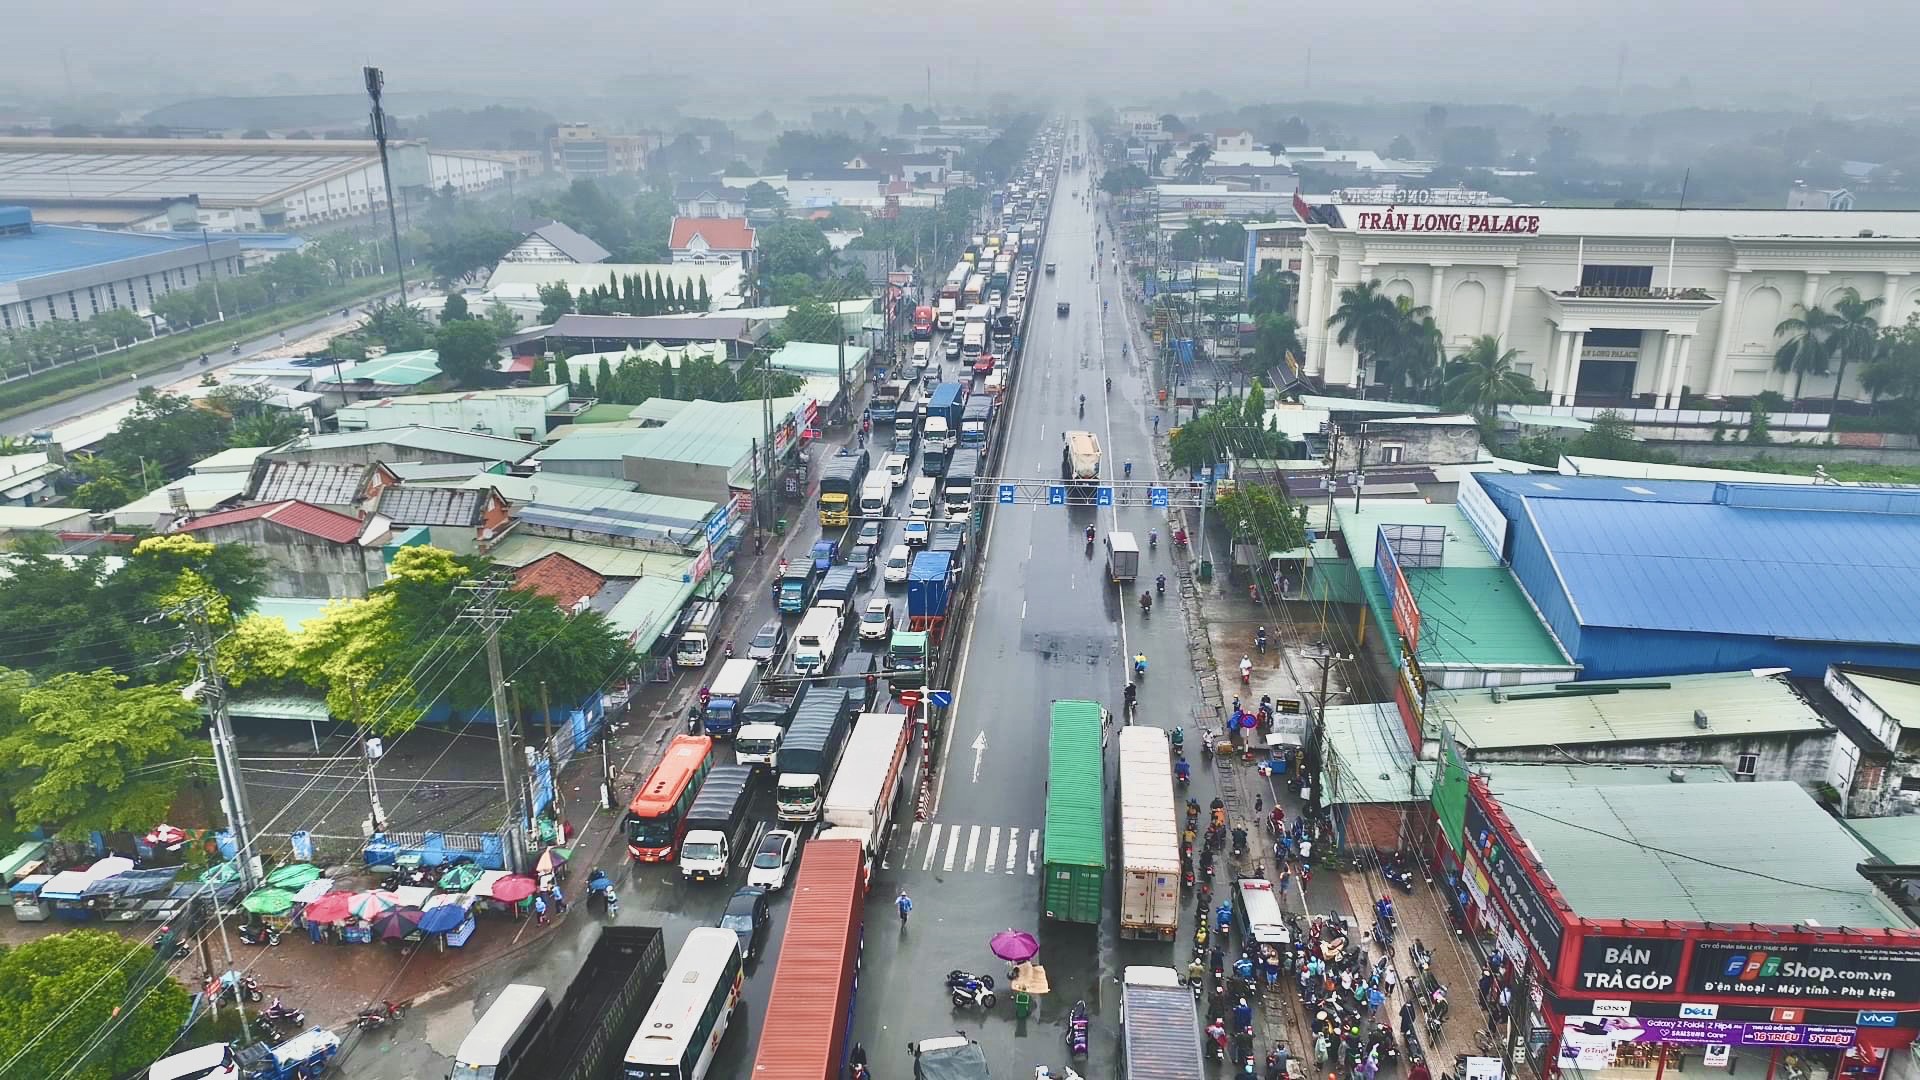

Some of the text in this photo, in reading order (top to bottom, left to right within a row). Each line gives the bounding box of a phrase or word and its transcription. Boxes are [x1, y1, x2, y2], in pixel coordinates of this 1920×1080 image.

[1358, 206, 1540, 234] TRẦN LONG PALACE
[1614, 286, 1650, 297] LONG
[1604, 944, 1651, 965] BÁN
[1583, 968, 1673, 990] TRẢ GÓP
[1735, 982, 1766, 994] thoại
[1778, 984, 1802, 995] Máy
[1806, 984, 1829, 995] tính
[1841, 986, 1864, 998] Phụ
[1869, 987, 1895, 999] kiện
[1684, 1007, 1713, 1016] DELL
[1647, 1020, 1677, 1029] Galaxy
[1714, 1022, 1733, 1031] Flip4
[1767, 1031, 1799, 1043] TRIỆU
[1819, 1033, 1851, 1045] TRIỆU
